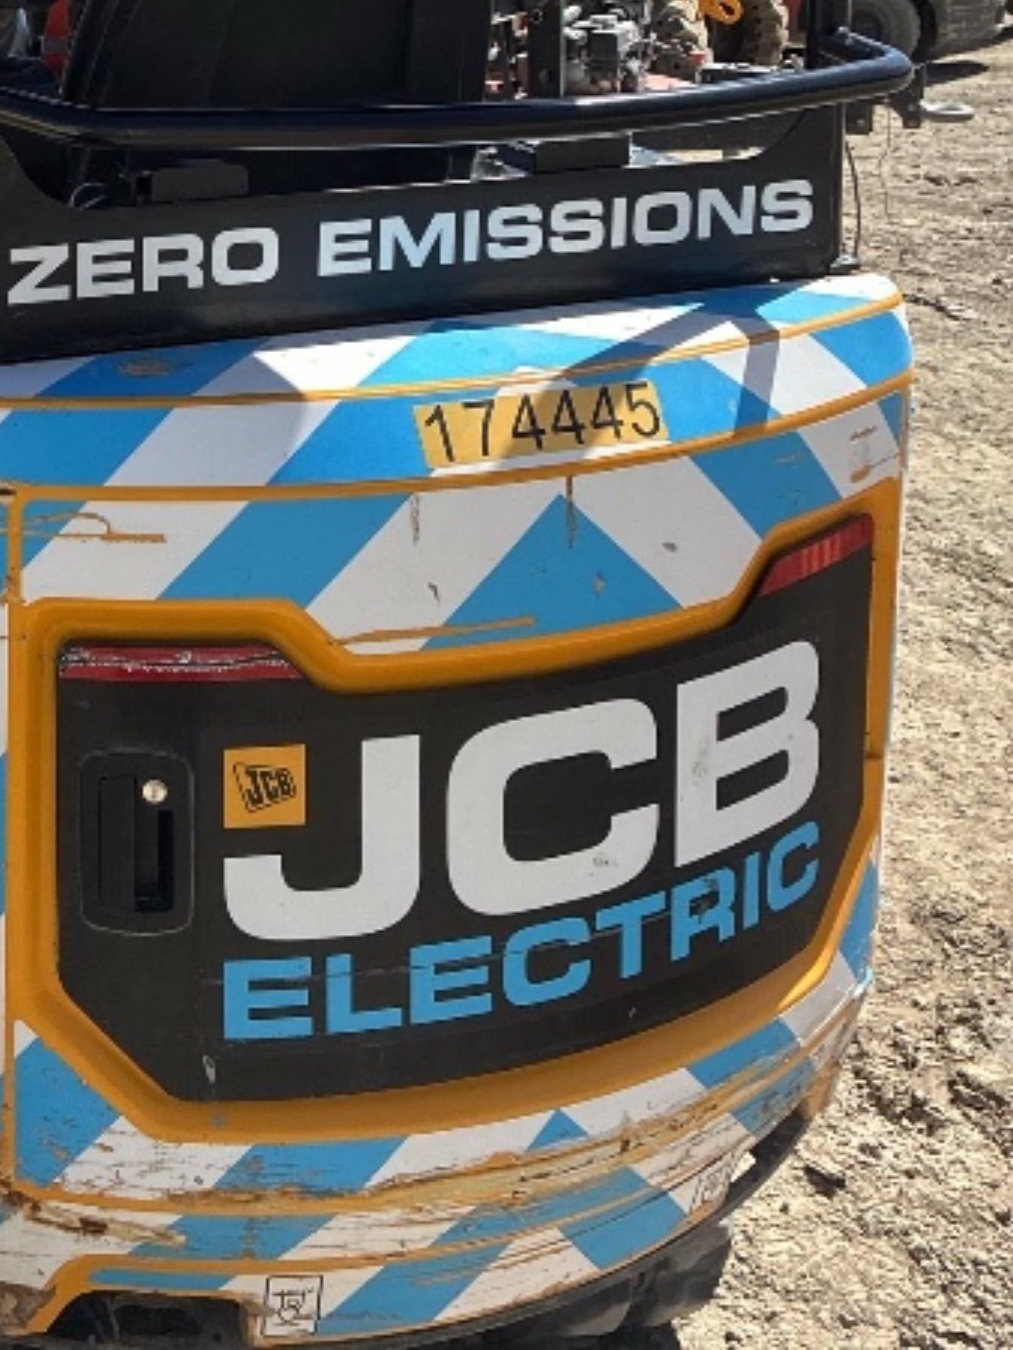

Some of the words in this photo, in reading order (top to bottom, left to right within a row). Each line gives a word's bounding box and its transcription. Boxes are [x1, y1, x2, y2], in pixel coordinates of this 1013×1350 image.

[7, 227, 279, 306] ZERO
[317, 179, 815, 278] EMISSIONS
[424, 381, 661, 463] 174445
[223, 640, 821, 941] JCB
[239, 764, 294, 809] JCB
[223, 819, 821, 1042] ELECTRIC
